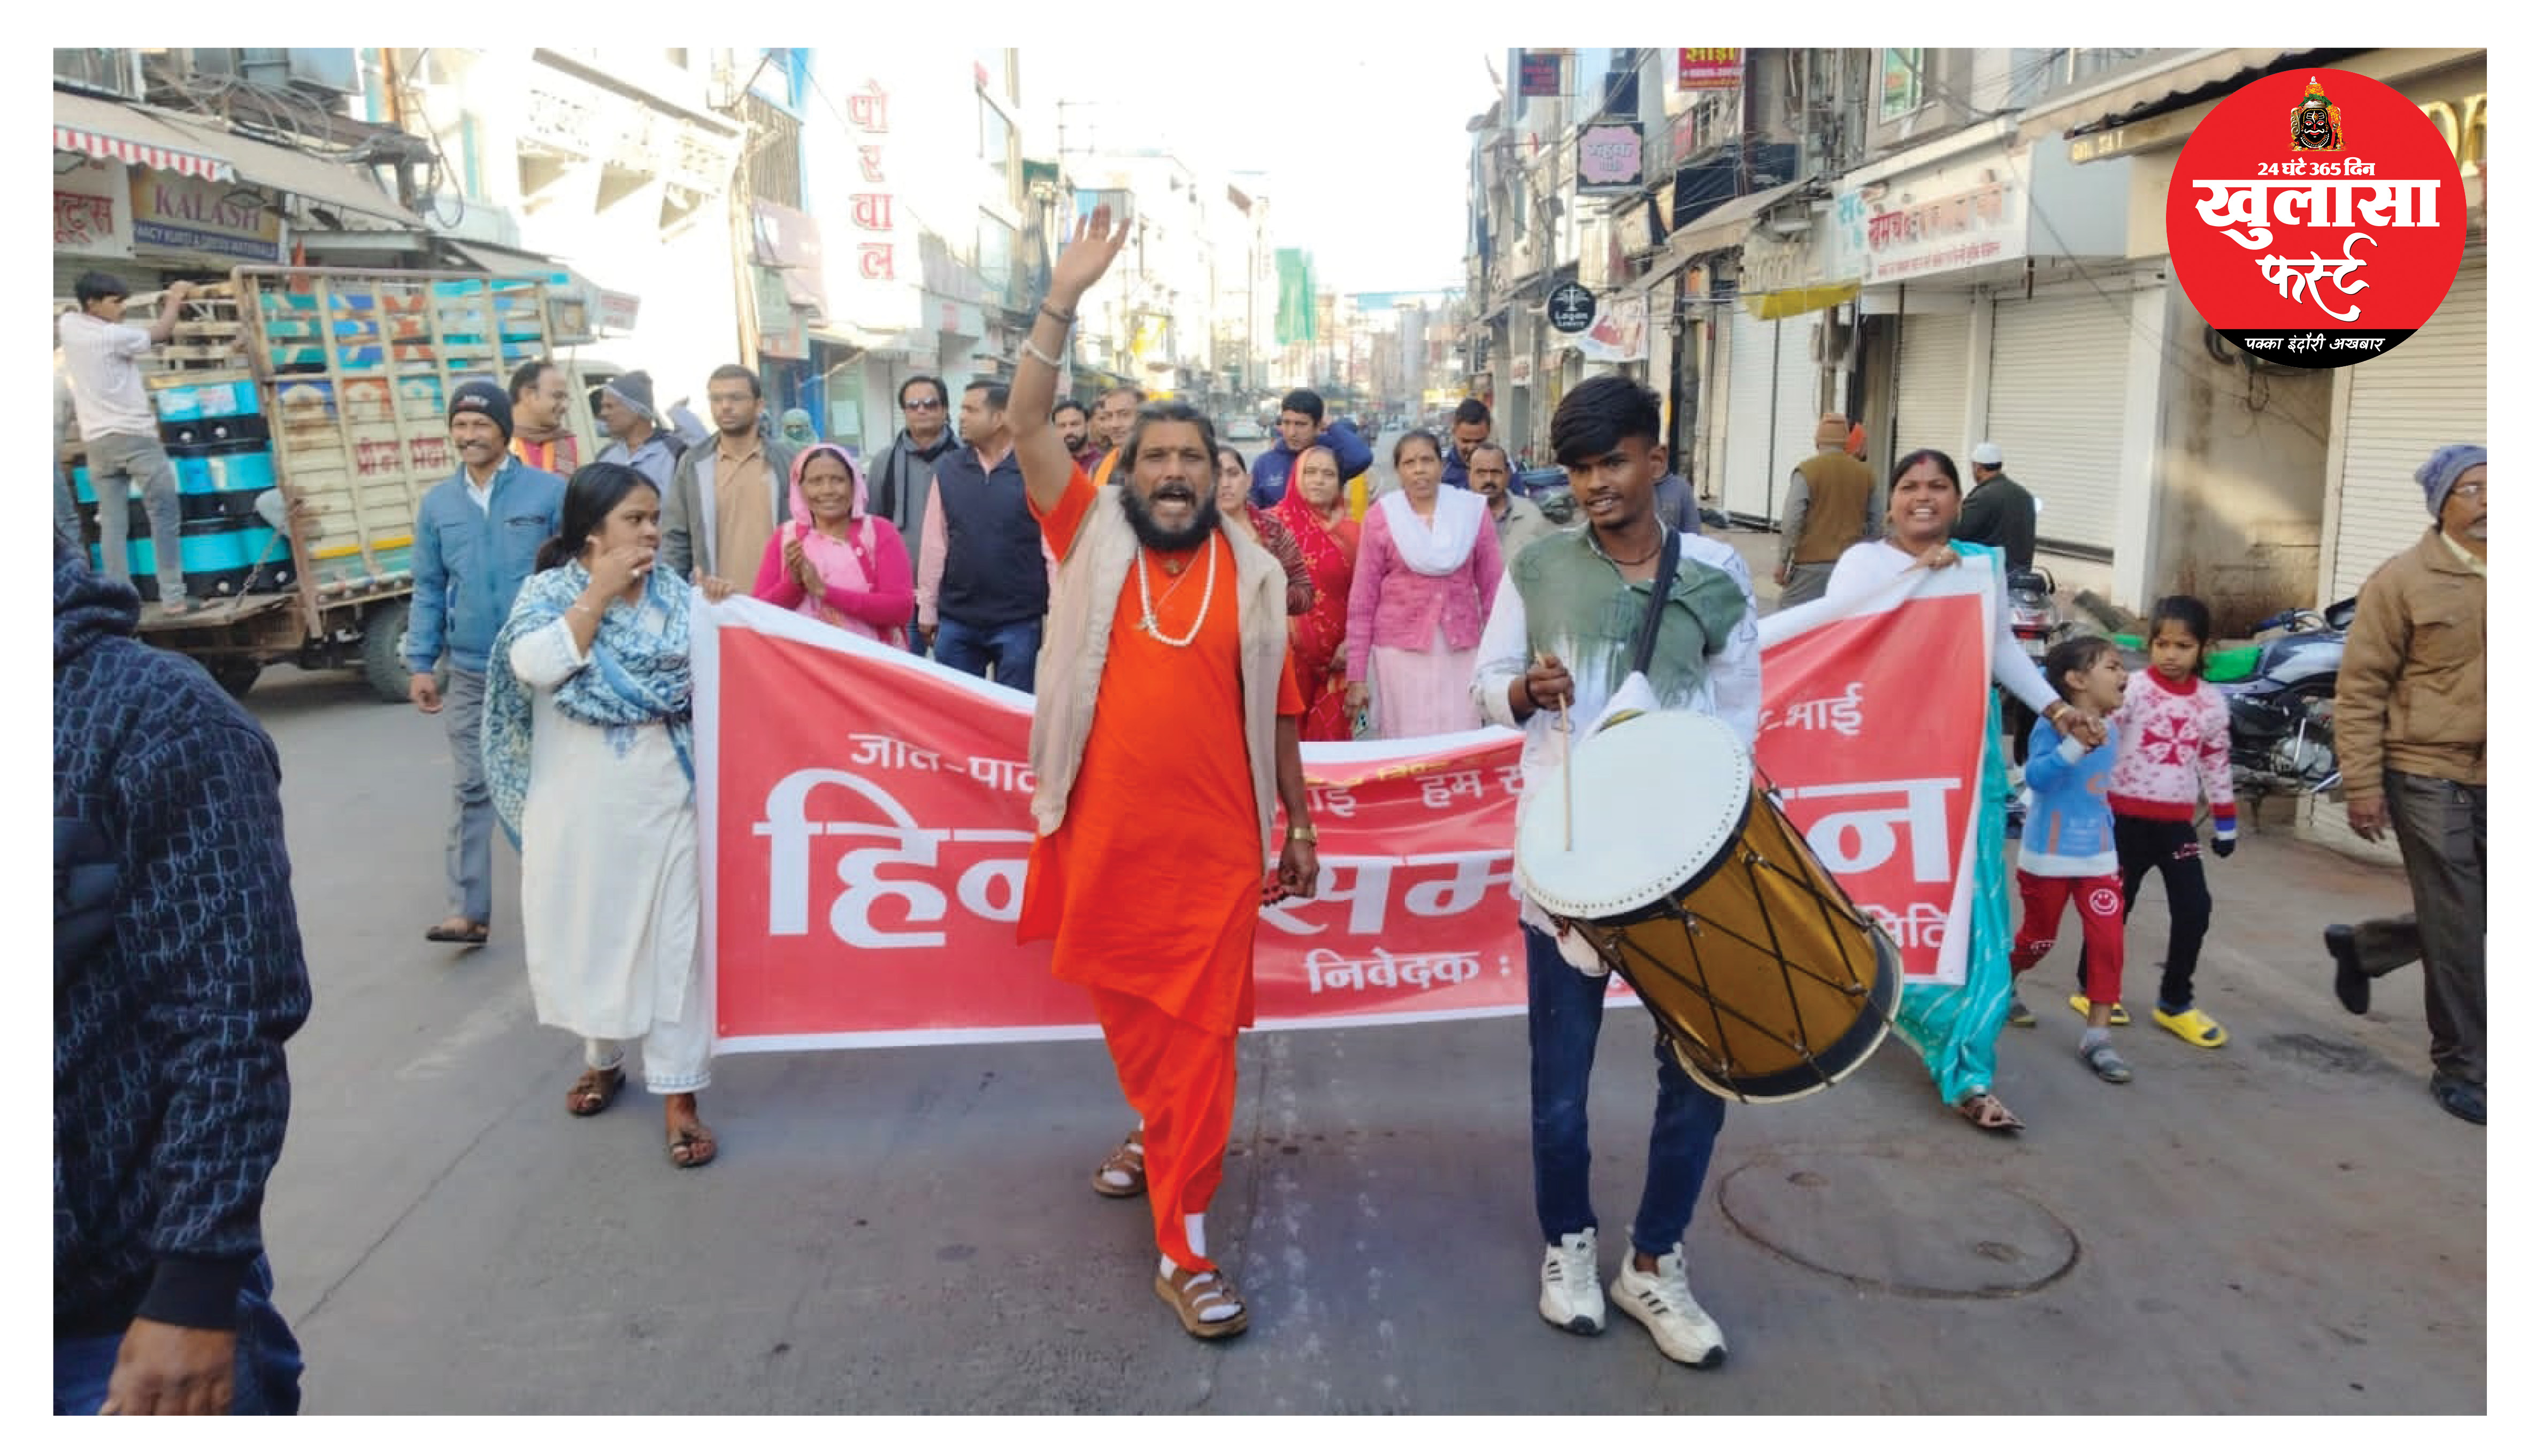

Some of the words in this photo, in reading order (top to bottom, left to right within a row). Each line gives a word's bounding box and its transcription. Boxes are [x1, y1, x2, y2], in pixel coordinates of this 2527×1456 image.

[155, 183, 260, 230] KALASH
[1415, 769, 1483, 808] हम
[1304, 948, 1480, 993] निवेदक
